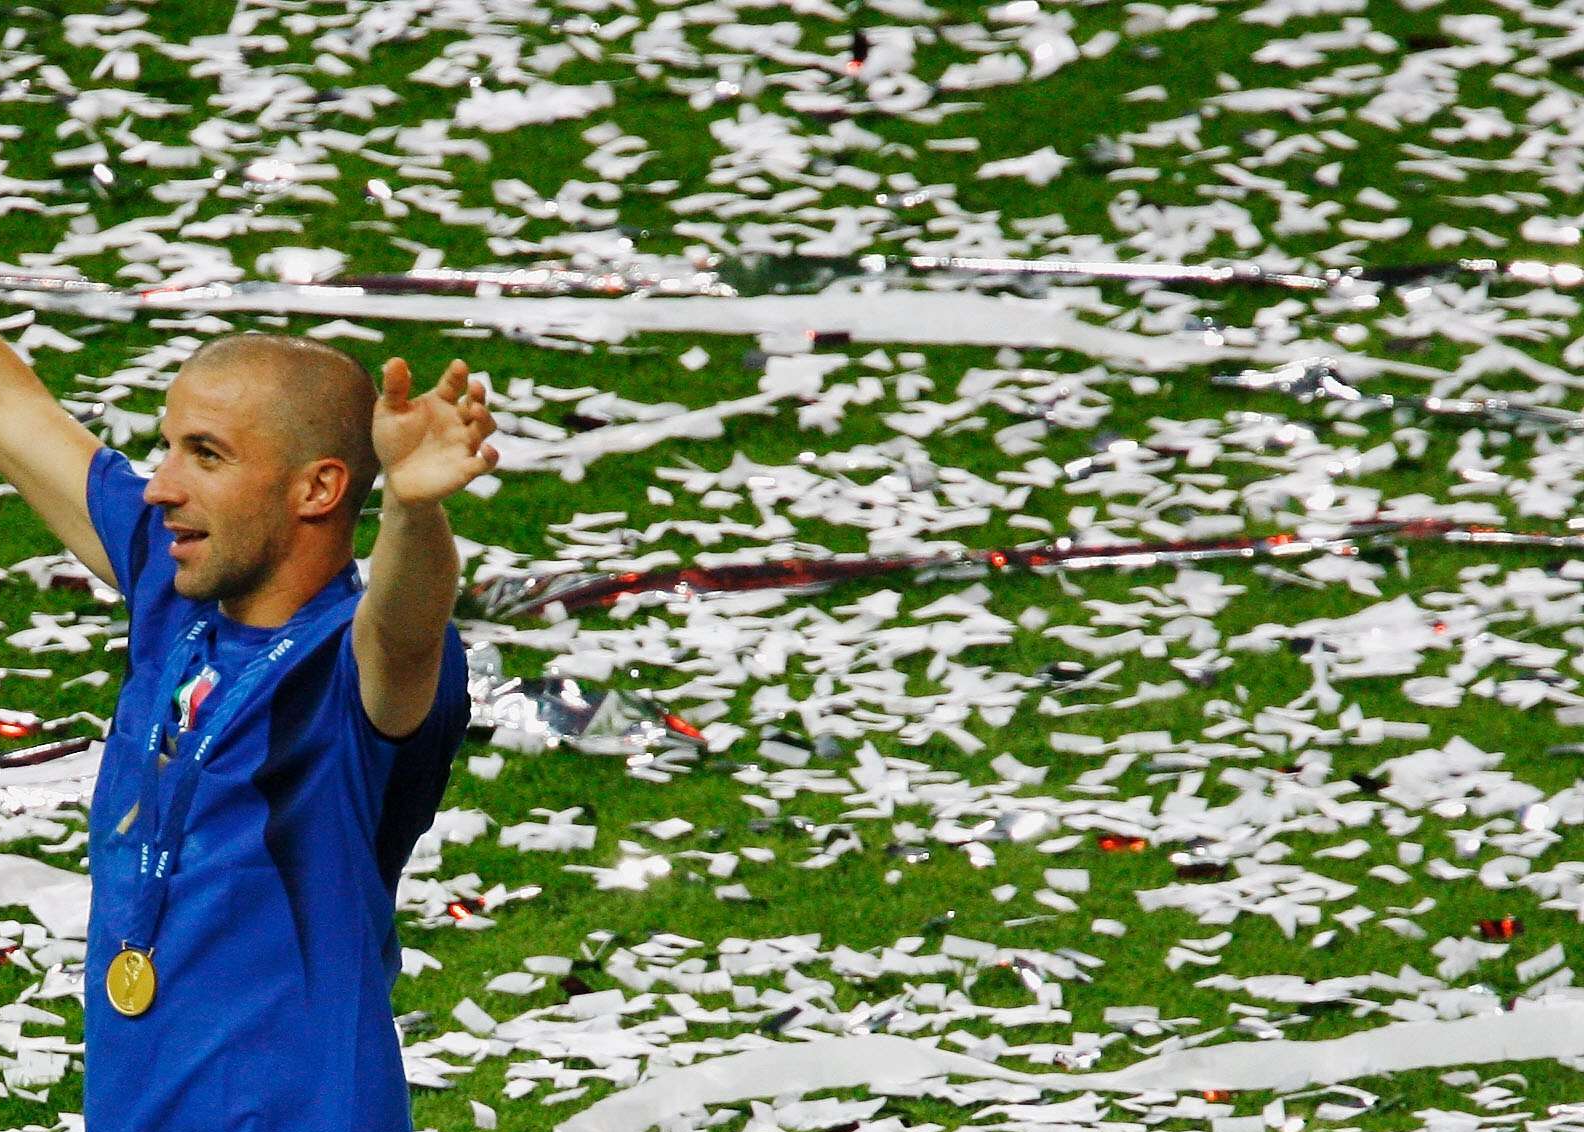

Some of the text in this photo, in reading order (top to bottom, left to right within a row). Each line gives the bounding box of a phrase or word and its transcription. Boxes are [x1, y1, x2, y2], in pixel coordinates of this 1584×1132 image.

[267, 639, 294, 661] FIFA
[149, 723, 160, 751] FIFA
[194, 735, 213, 761] FIFA
[155, 851, 169, 878] FIFA
